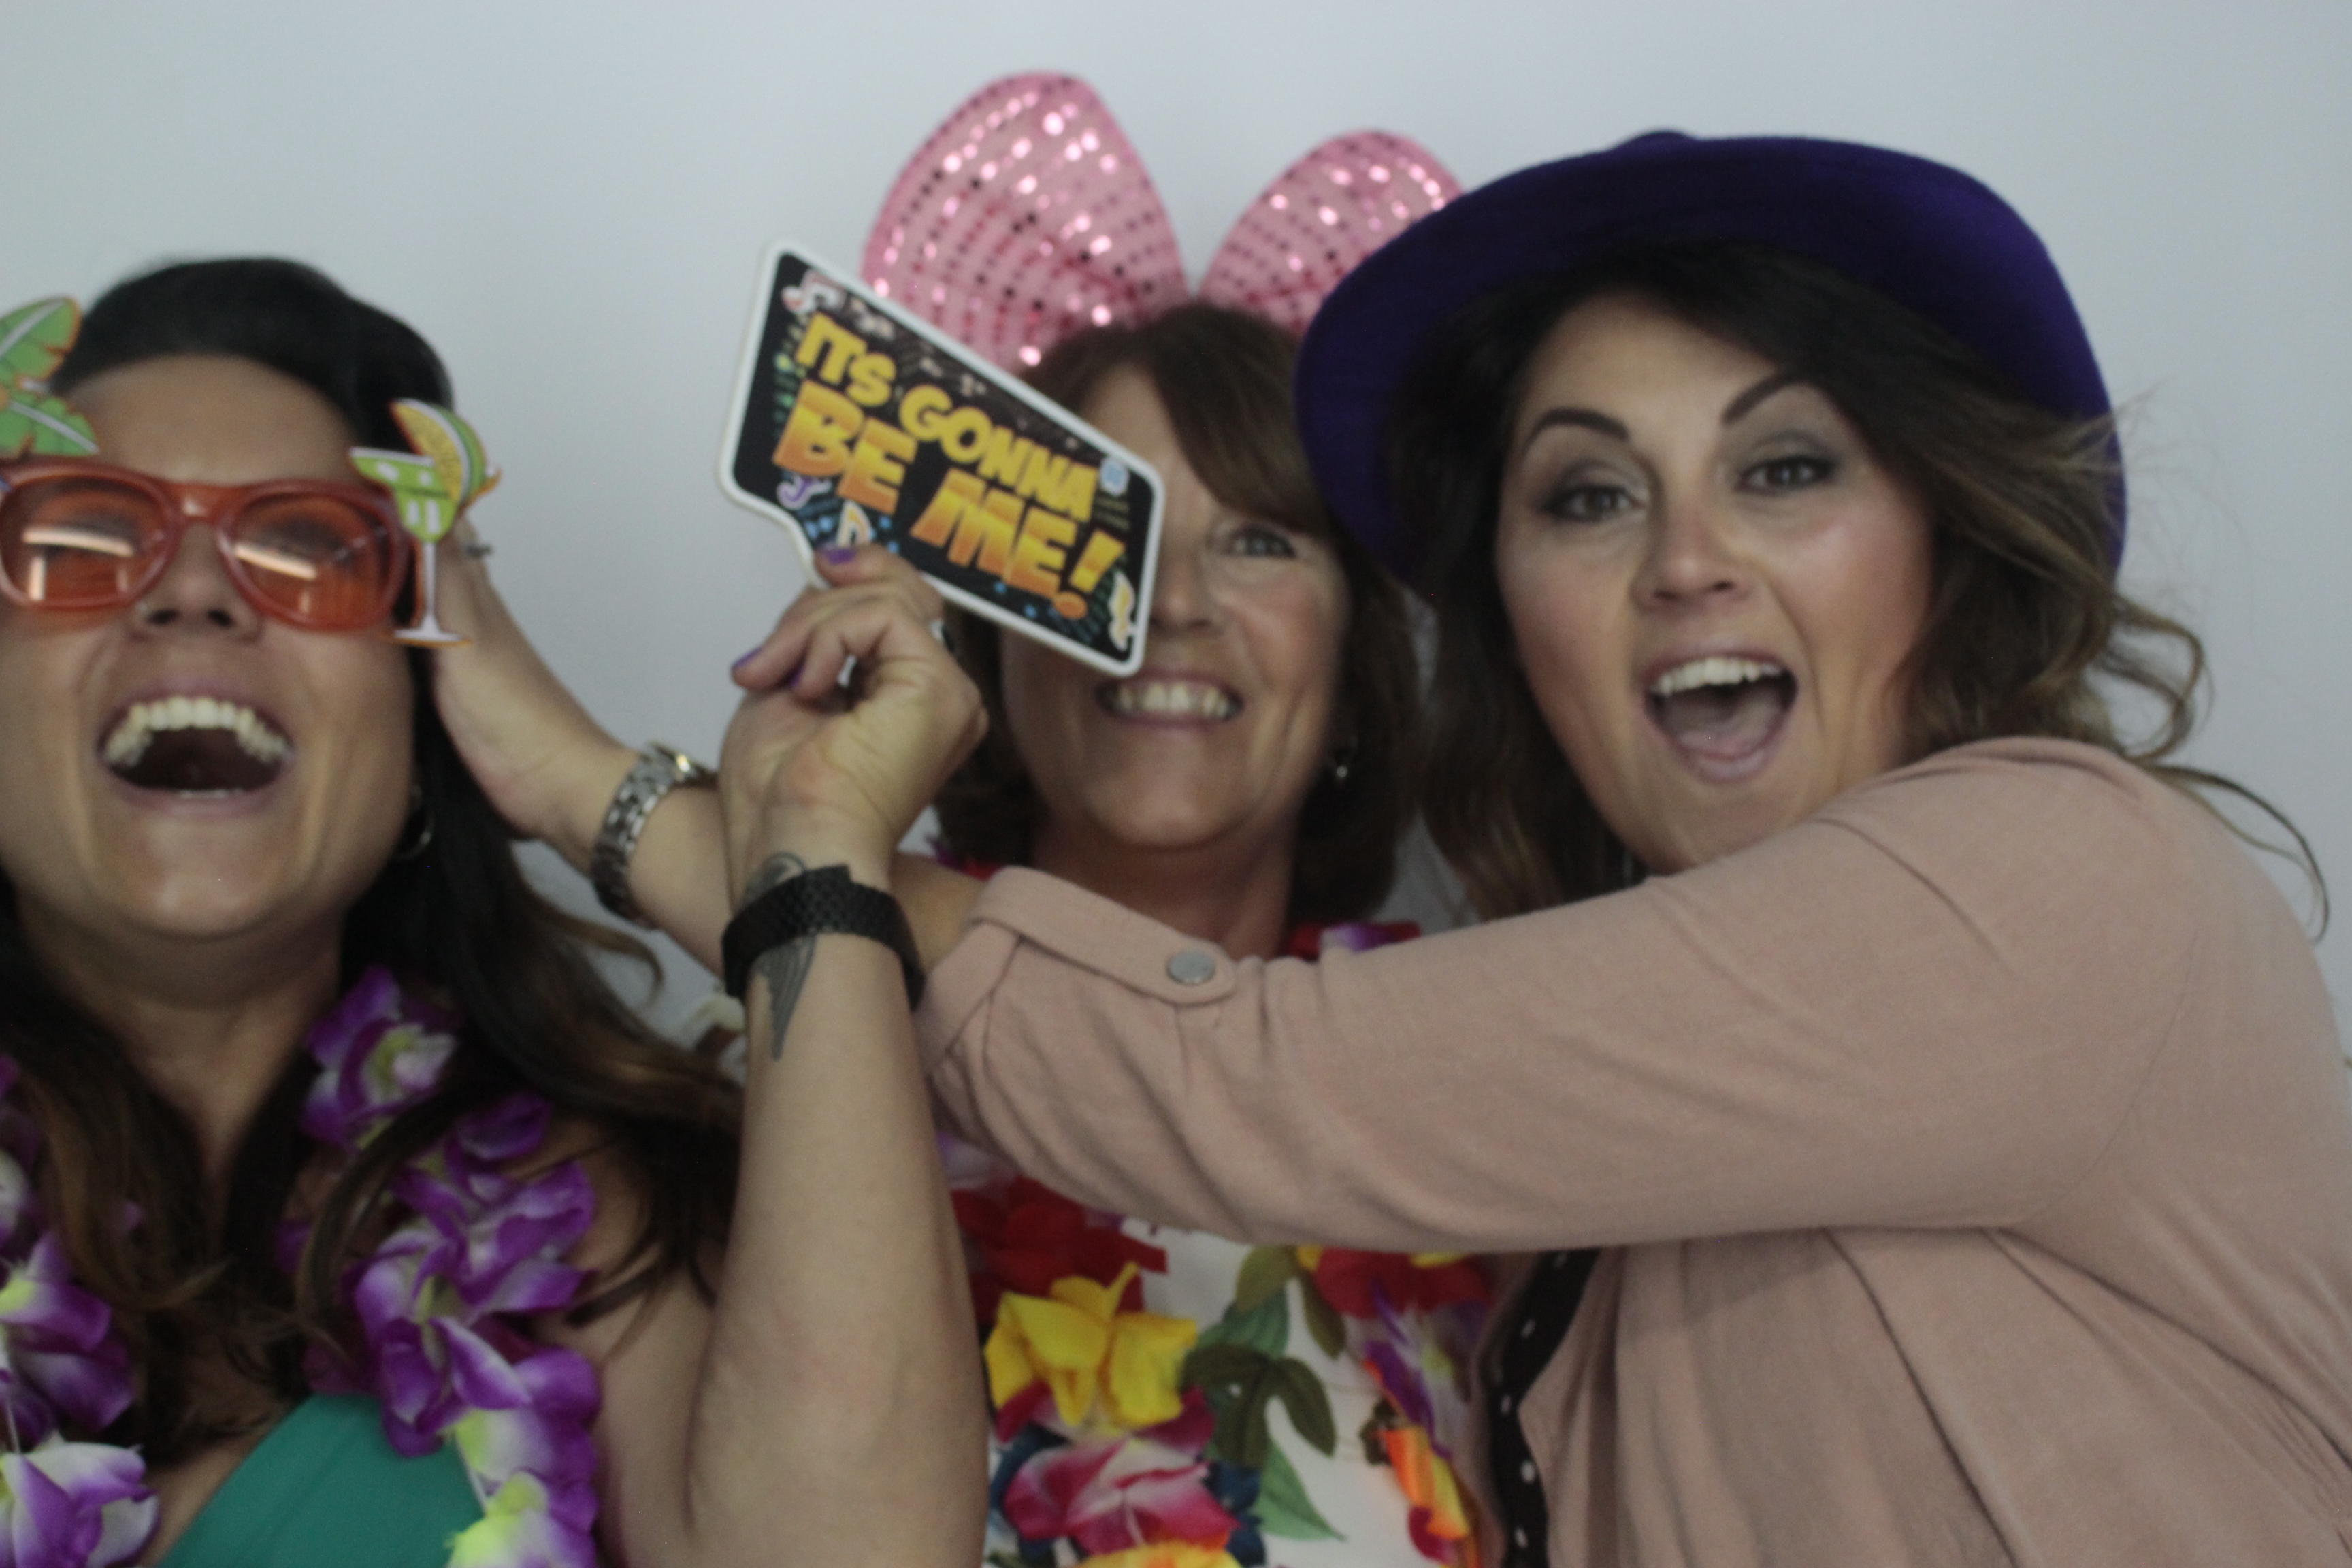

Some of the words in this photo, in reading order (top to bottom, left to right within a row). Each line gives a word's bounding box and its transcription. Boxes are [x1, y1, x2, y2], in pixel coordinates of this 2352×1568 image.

[773, 380, 918, 515] BE
[910, 468, 1124, 619] ME!
[899, 385, 1099, 522] GONNA
